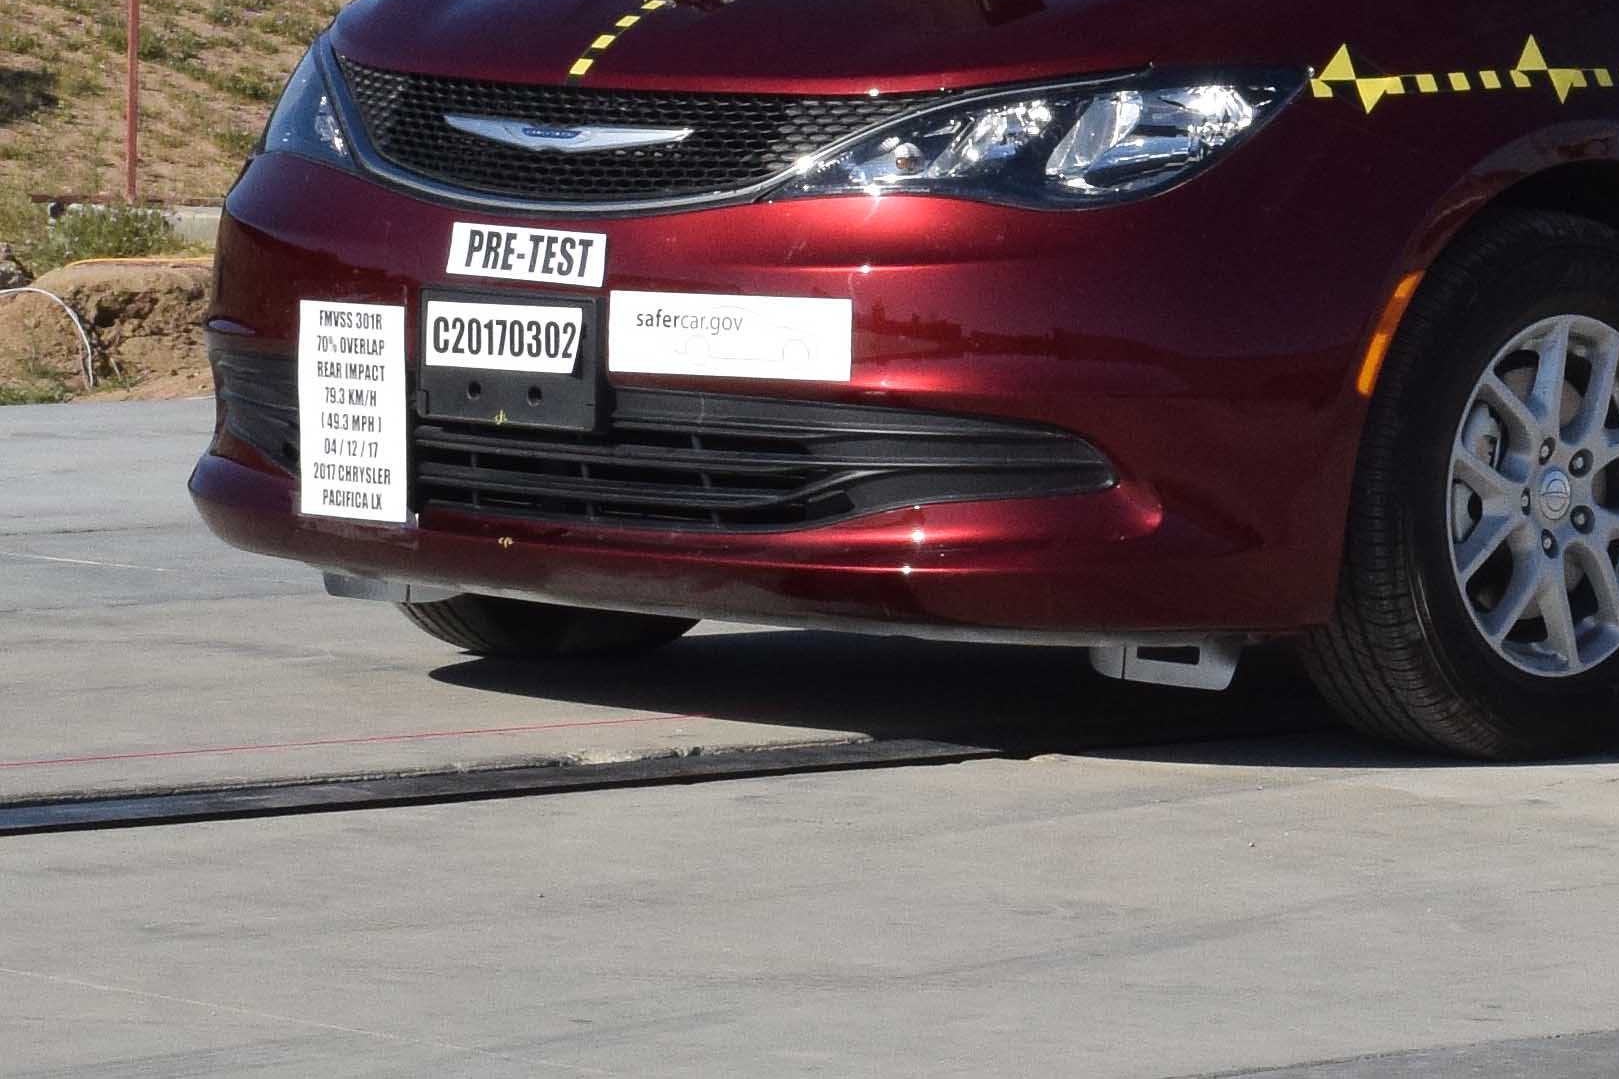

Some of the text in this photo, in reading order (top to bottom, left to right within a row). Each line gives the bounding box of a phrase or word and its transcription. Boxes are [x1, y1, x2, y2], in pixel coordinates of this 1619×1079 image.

[465, 228, 594, 277] PRE-TEST
[320, 309, 382, 330] FMVSS 301R
[636, 308, 743, 335] safercar.gov
[316, 335, 385, 356] 70% OVERLAP
[433, 316, 576, 359] C20170302
[317, 361, 385, 382] REAR IMPACT
[325, 386, 377, 407] 79.3 KM/H
[313, 461, 391, 485] 2017 CHRYSLER
[322, 488, 383, 510] PACIFICA LX
